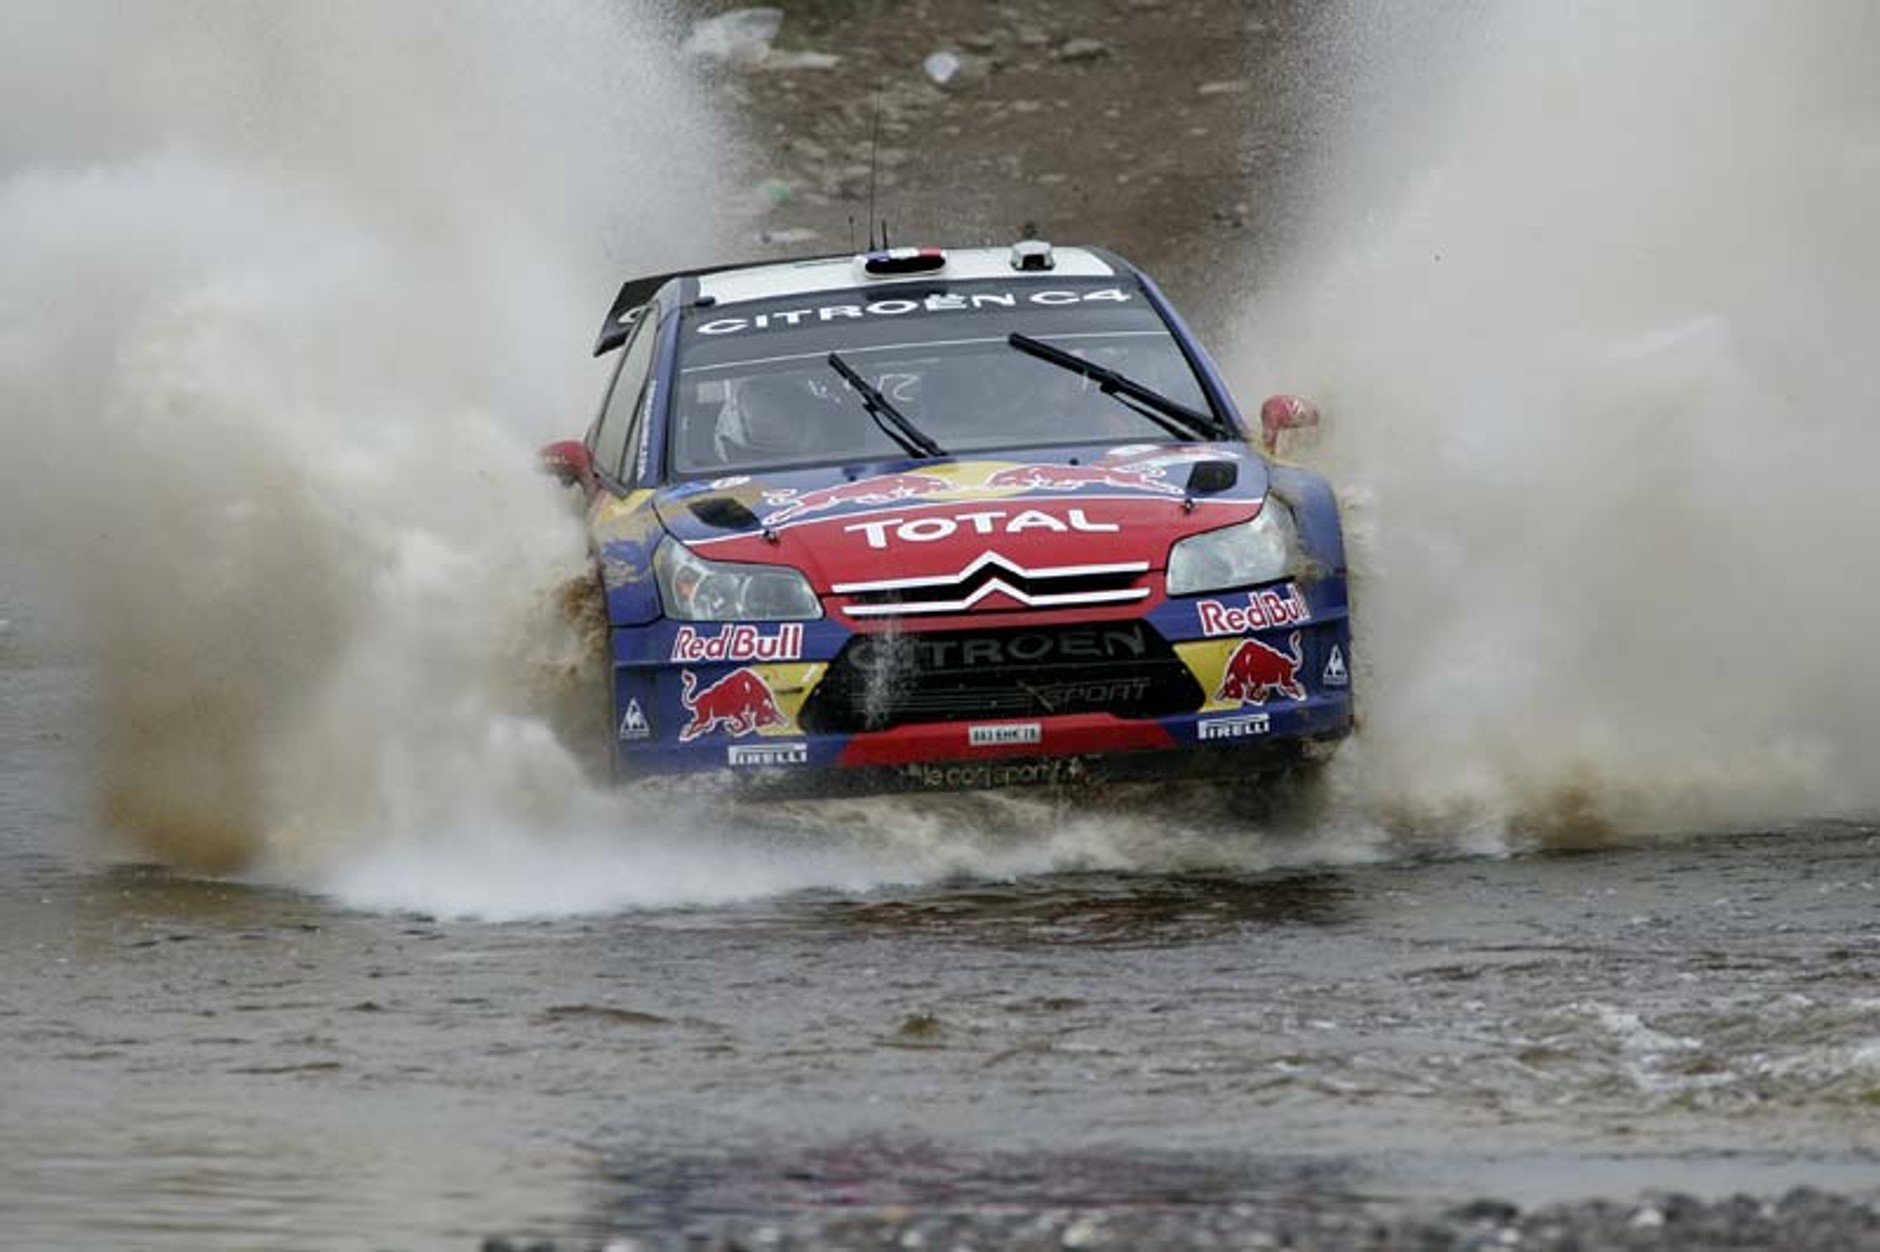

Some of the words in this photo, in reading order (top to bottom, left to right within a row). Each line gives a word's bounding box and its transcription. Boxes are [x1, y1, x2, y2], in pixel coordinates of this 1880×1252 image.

[1029, 288, 1131, 305] C4
[844, 509, 1120, 549] TOTAL
[1196, 592, 1268, 638] Red
[670, 624, 733, 662] Red
[728, 623, 803, 661] Bull
[1199, 713, 1269, 739] PIRELLI
[728, 743, 807, 765] PIRELLI
